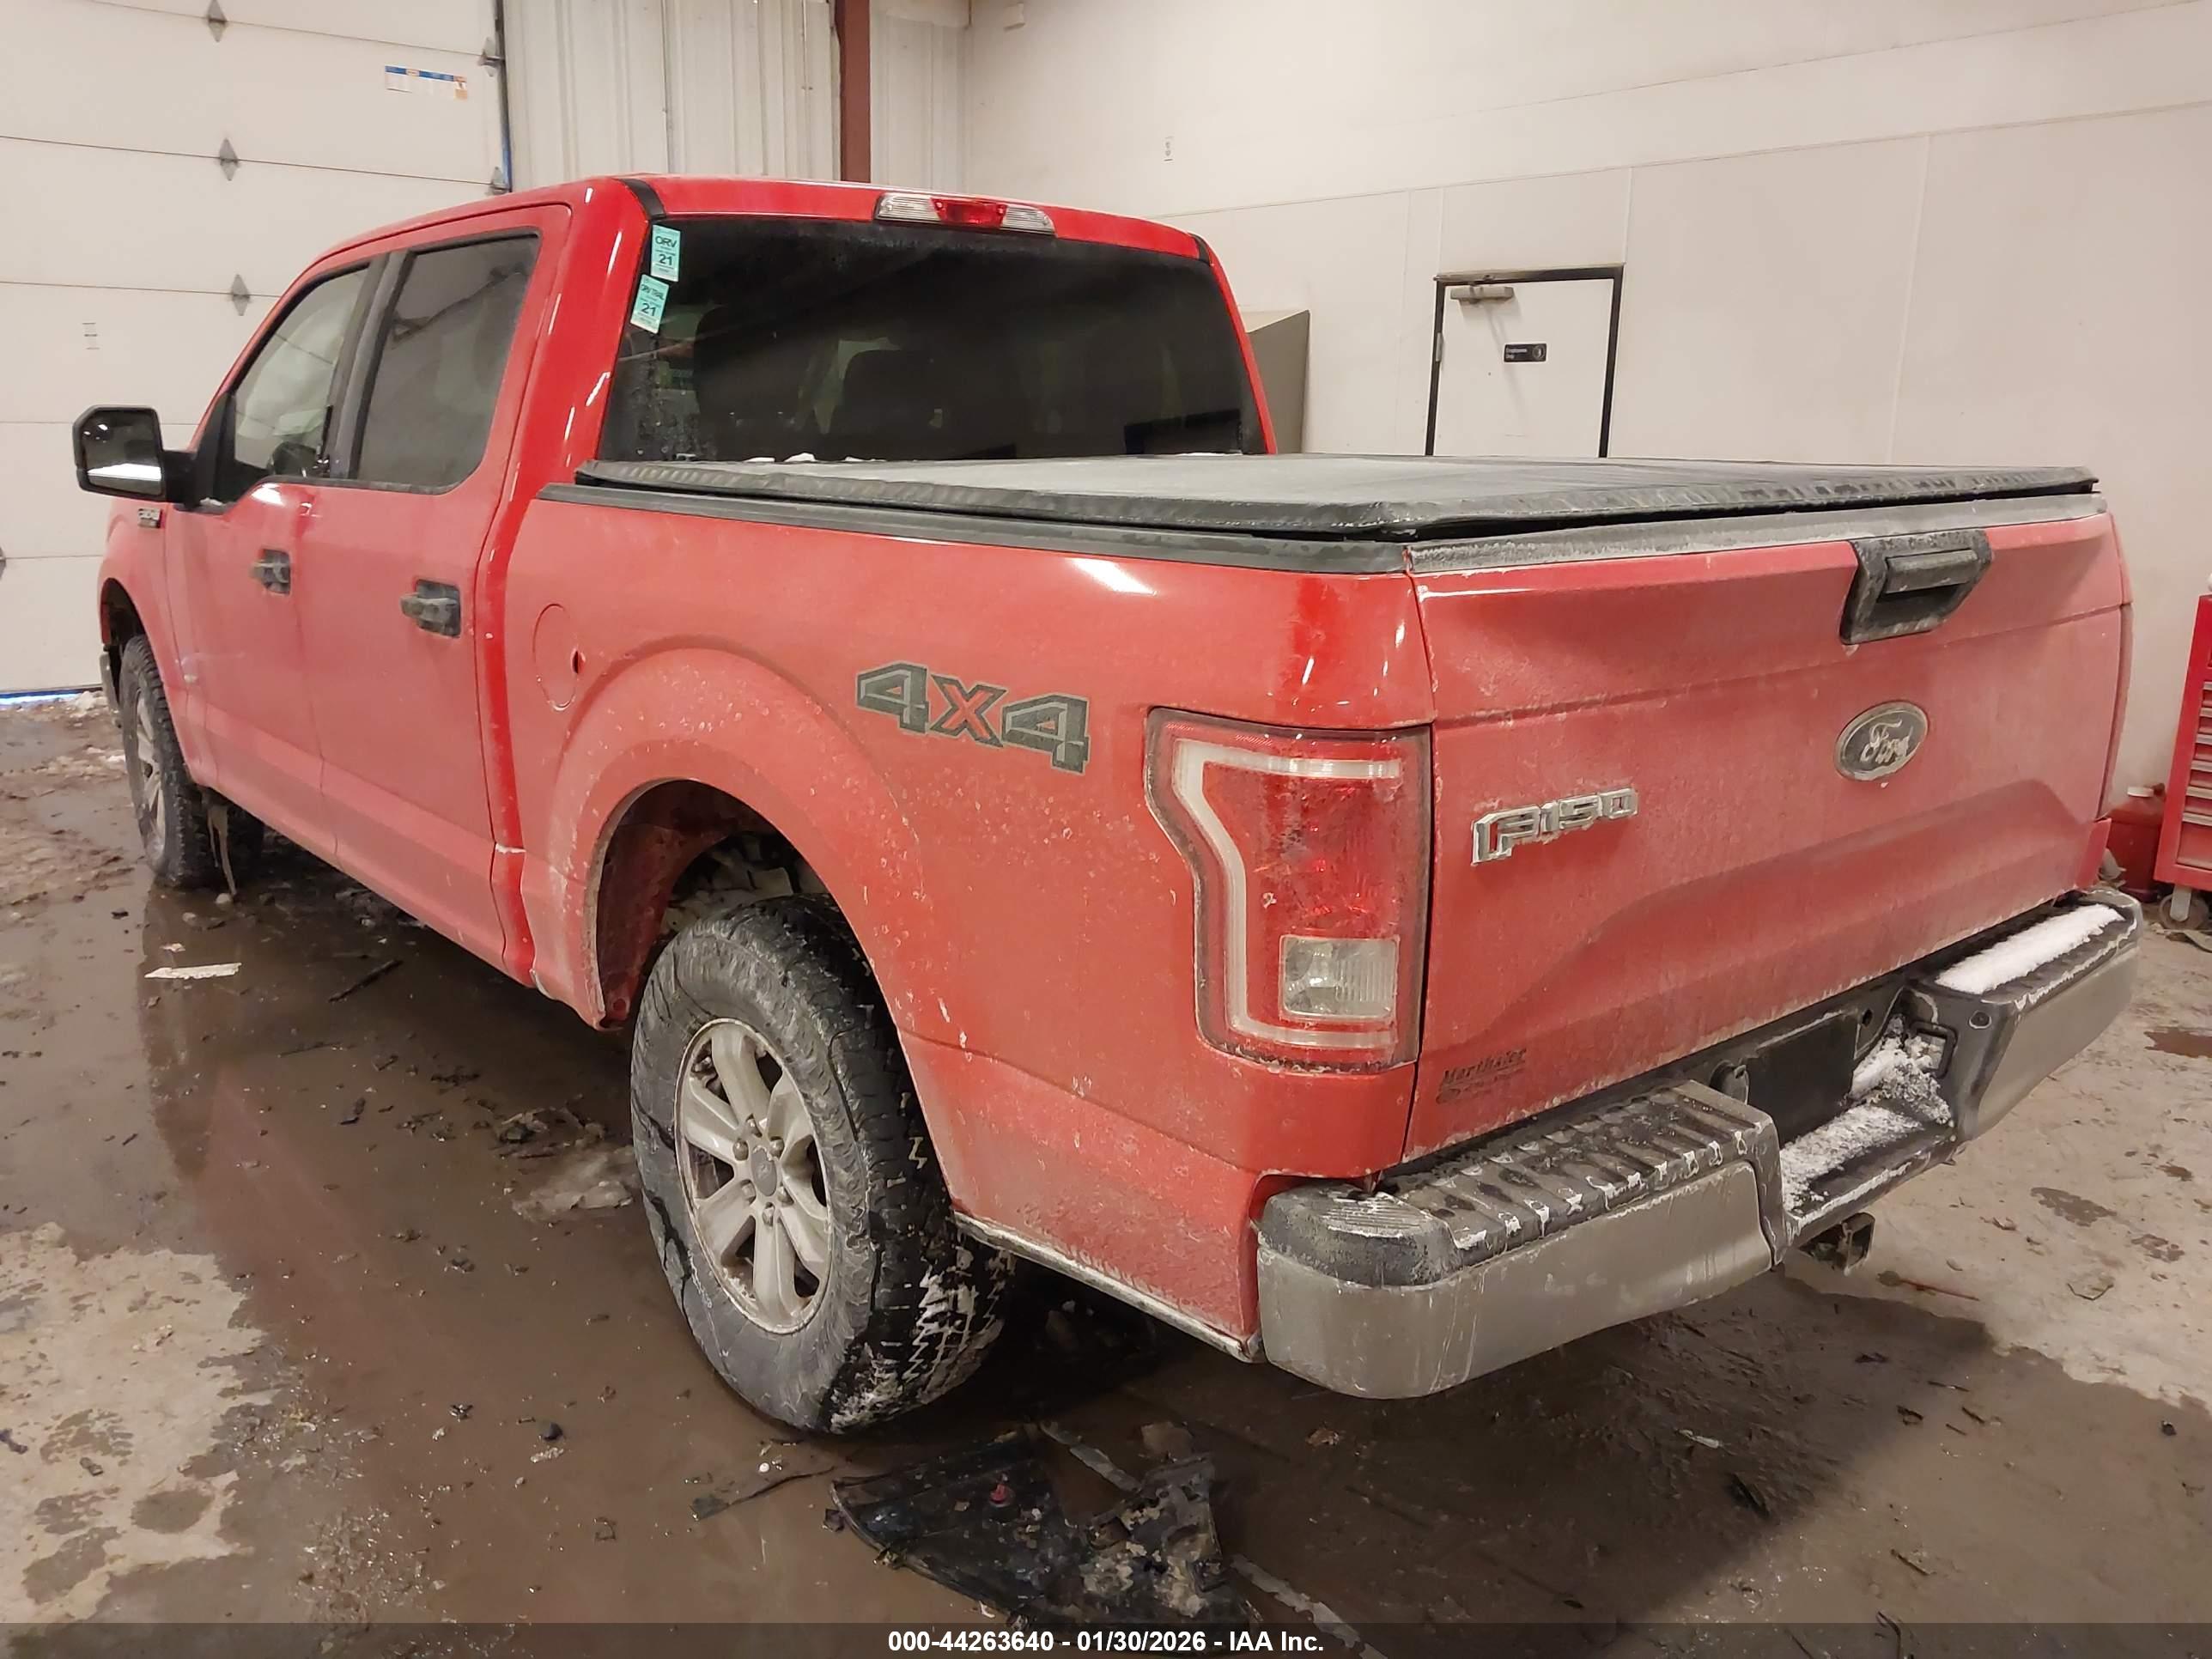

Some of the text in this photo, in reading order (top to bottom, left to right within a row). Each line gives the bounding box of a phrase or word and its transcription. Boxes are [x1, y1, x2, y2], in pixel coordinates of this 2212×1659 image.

[655, 236, 677, 247] ORV
[659, 253, 672, 266] 21
[641, 302, 656, 317] 21
[1859, 719, 1914, 764] Ford
